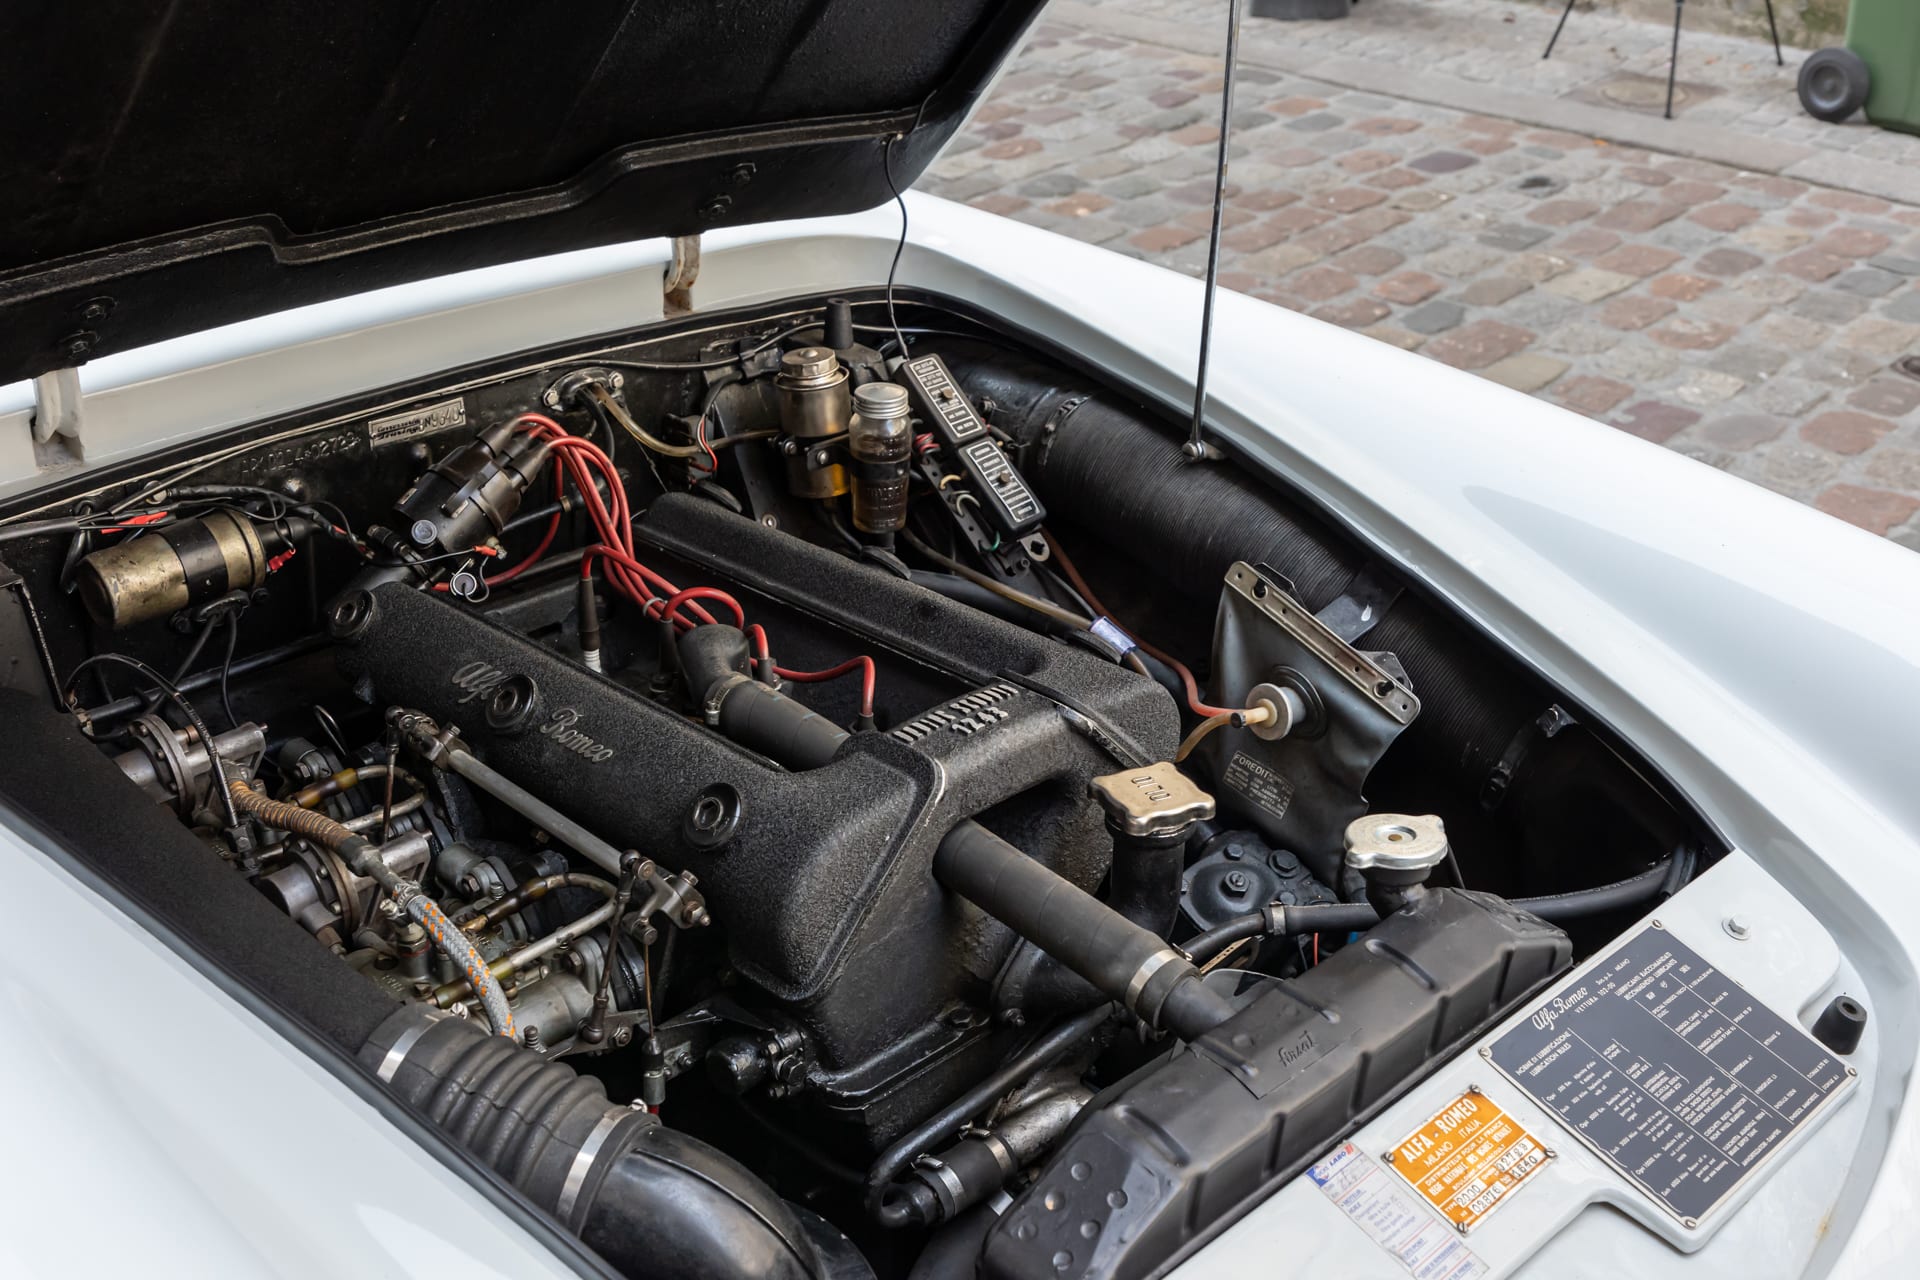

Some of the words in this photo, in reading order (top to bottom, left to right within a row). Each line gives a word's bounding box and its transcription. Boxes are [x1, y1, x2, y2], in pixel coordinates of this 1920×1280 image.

[540, 708, 614, 763] Romeo
[951, 706, 1009, 734] 1243
[1532, 1007, 1561, 1030] Alfa
[1551, 987, 1588, 1013] Romeo
[1574, 996, 1598, 1013] VETTURA
[1529, 1052, 1559, 1076] LUBRICATION
[1401, 1134, 1434, 1162] ALFA
[1435, 1099, 1477, 1133] ROMEO
[1424, 1141, 1453, 1167] MILANO
[1458, 1119, 1482, 1138] ITALIA
[1329, 1151, 1346, 1166] LABO
[1425, 1154, 1461, 1186] DISTRIBUTEUR
[1461, 1142, 1476, 1156] POUR
[1476, 1136, 1485, 1144] LA
[1484, 1120, 1503, 1137] FRANCE
[1454, 1184, 1482, 1206] 2000
[1493, 1141, 1528, 1173] 02729
[1469, 1184, 1504, 1213] 02876
